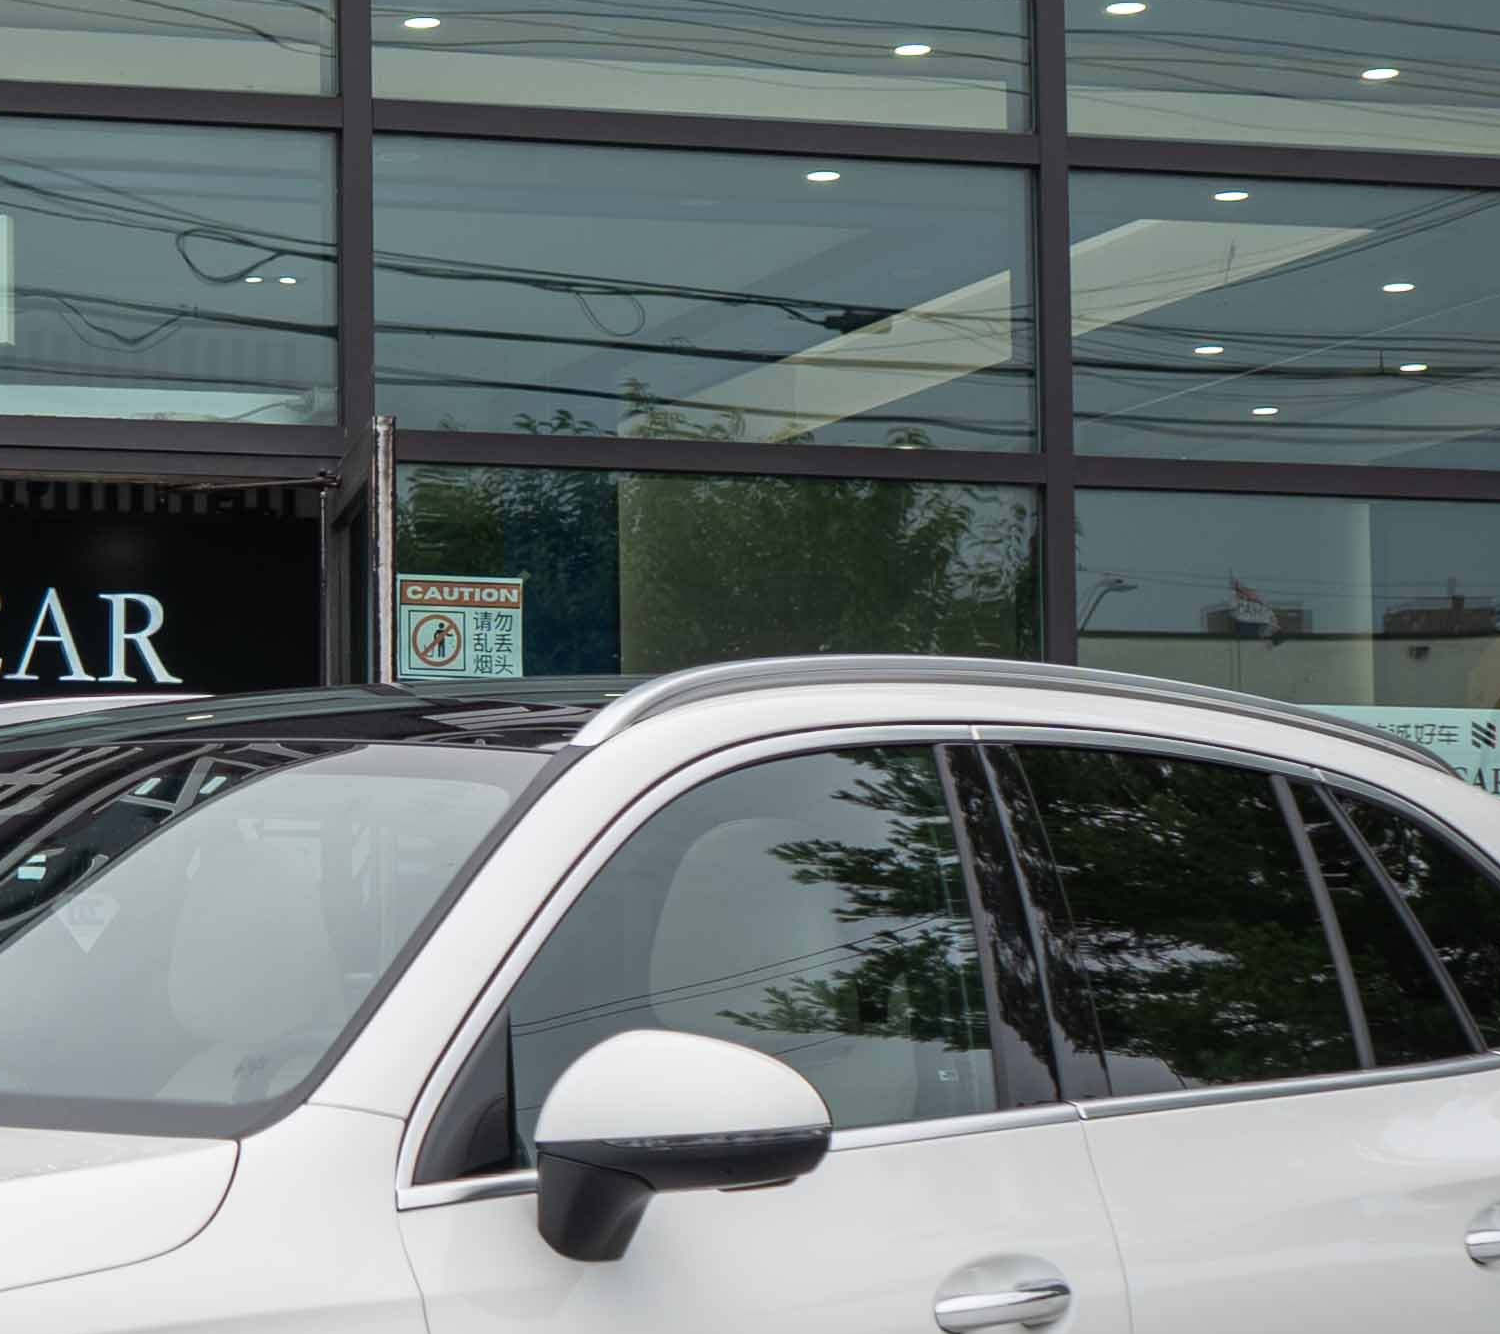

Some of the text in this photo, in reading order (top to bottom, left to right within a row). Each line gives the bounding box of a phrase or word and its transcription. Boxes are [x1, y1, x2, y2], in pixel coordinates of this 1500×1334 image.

[406, 585, 520, 603] CAUTION
[473, 611, 514, 632] 请勿
[473, 633, 514, 653] 乱丢
[473, 654, 514, 675] 烟头
[1376, 722, 1461, 746] 诚好车
